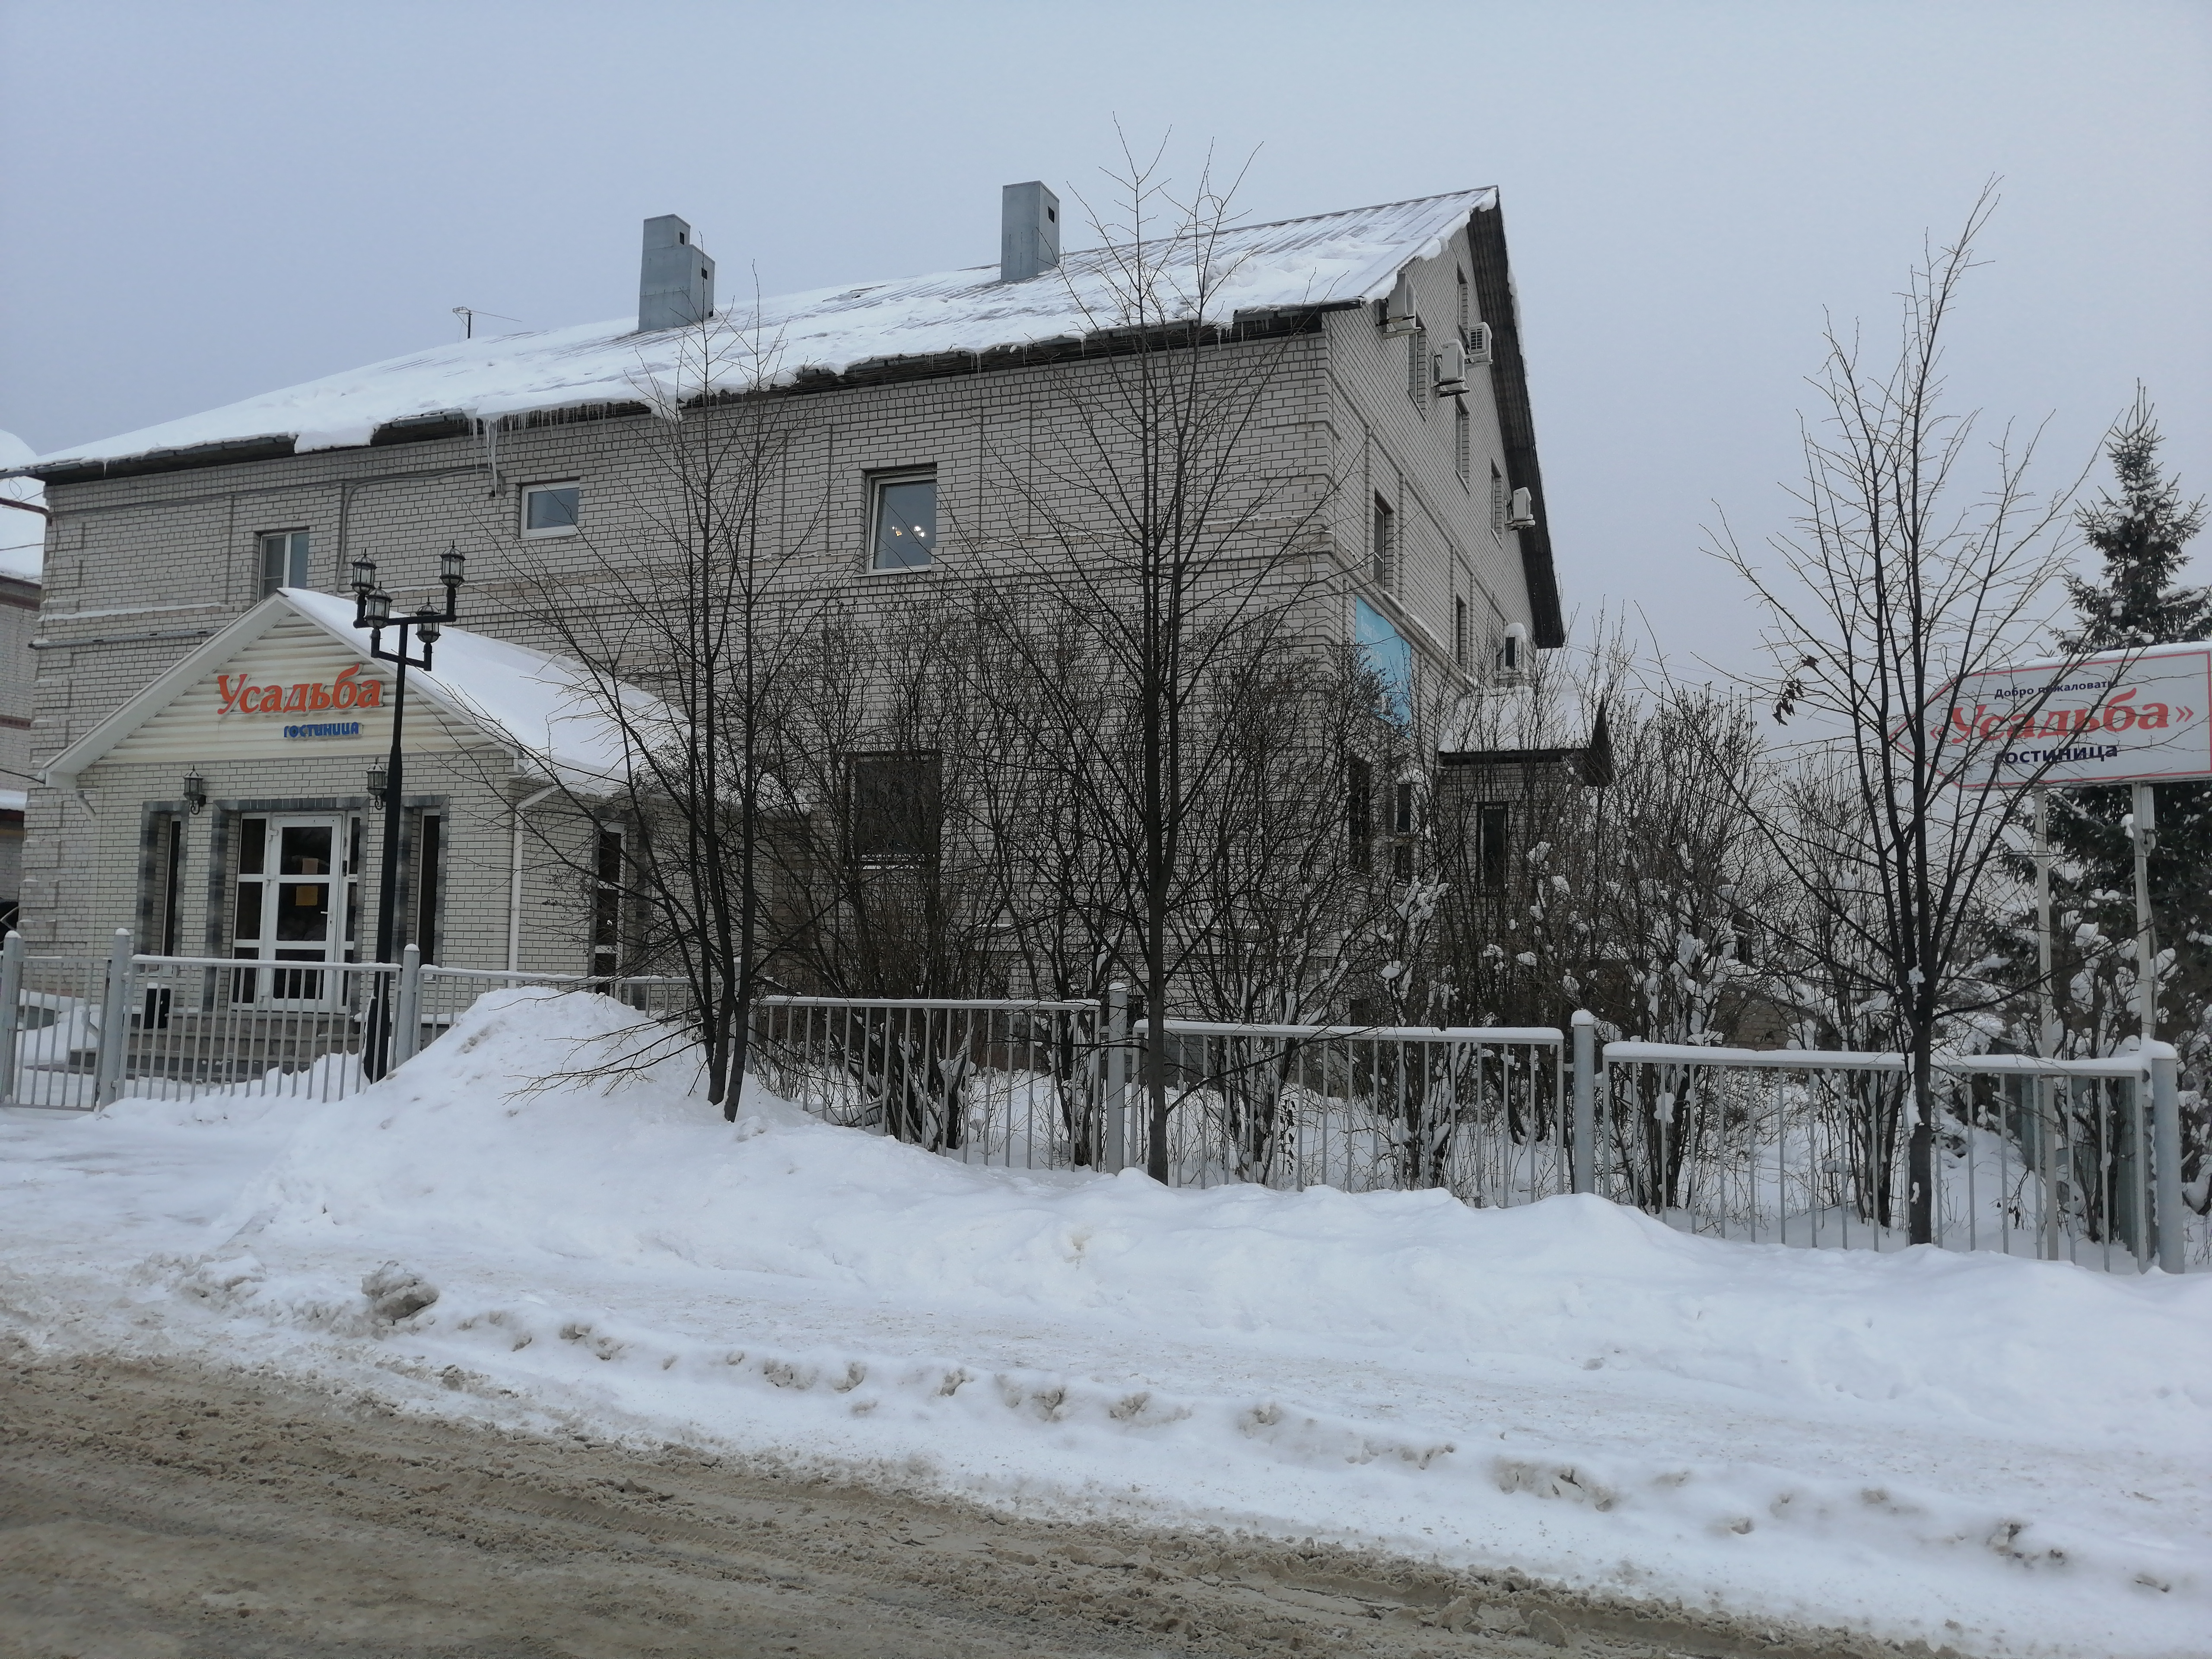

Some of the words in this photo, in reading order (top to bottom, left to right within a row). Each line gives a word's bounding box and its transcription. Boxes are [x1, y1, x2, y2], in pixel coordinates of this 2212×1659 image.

[217, 663, 383, 714] Усадьба
[1994, 686, 2034, 699] Добро
[2038, 681, 2113, 694] пжаловать
[2000, 745, 2118, 763] остиница
